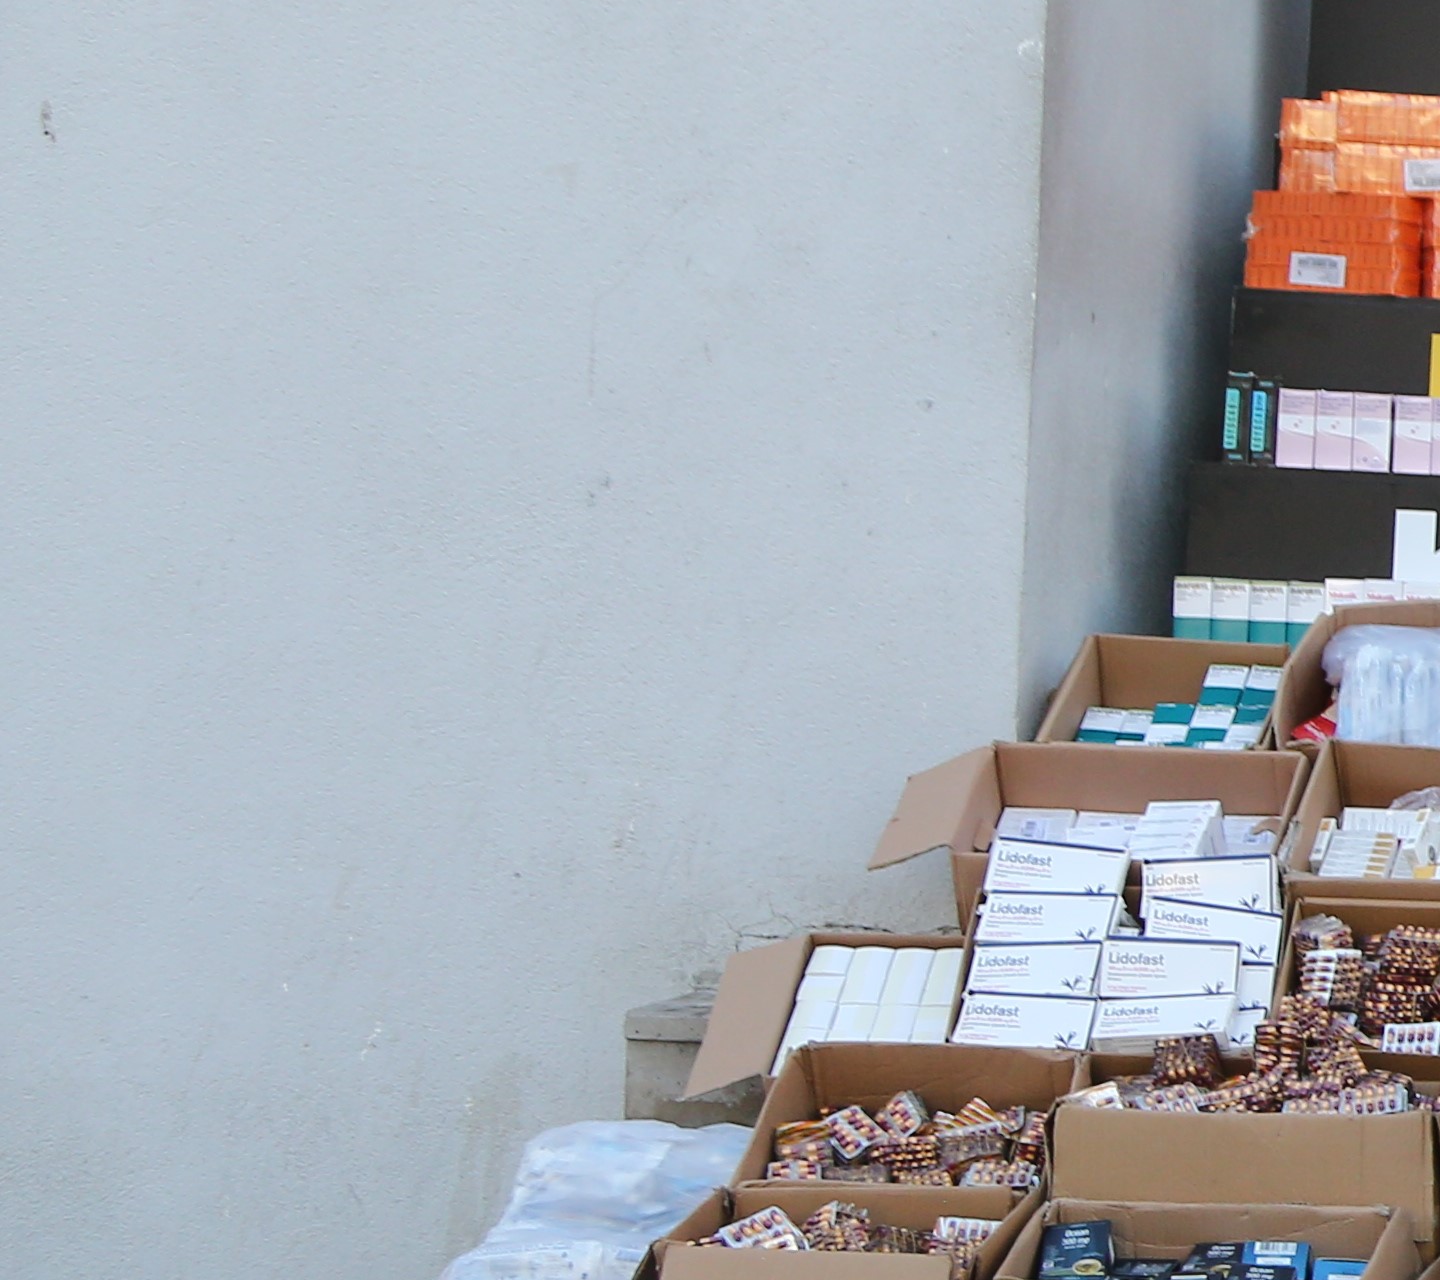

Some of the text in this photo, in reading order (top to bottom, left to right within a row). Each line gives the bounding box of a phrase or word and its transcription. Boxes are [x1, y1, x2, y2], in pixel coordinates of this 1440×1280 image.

[997, 849, 1053, 869] Lidofast
[1145, 873, 1200, 888] Lidofast
[989, 902, 1044, 917] Lidofast
[1153, 908, 1210, 927] Lidofast
[977, 954, 1031, 969] Lidofast
[1107, 950, 1165, 966] Lidofast
[964, 1003, 1020, 1018] Lidofast
[1102, 1004, 1160, 1018] Lidofast
